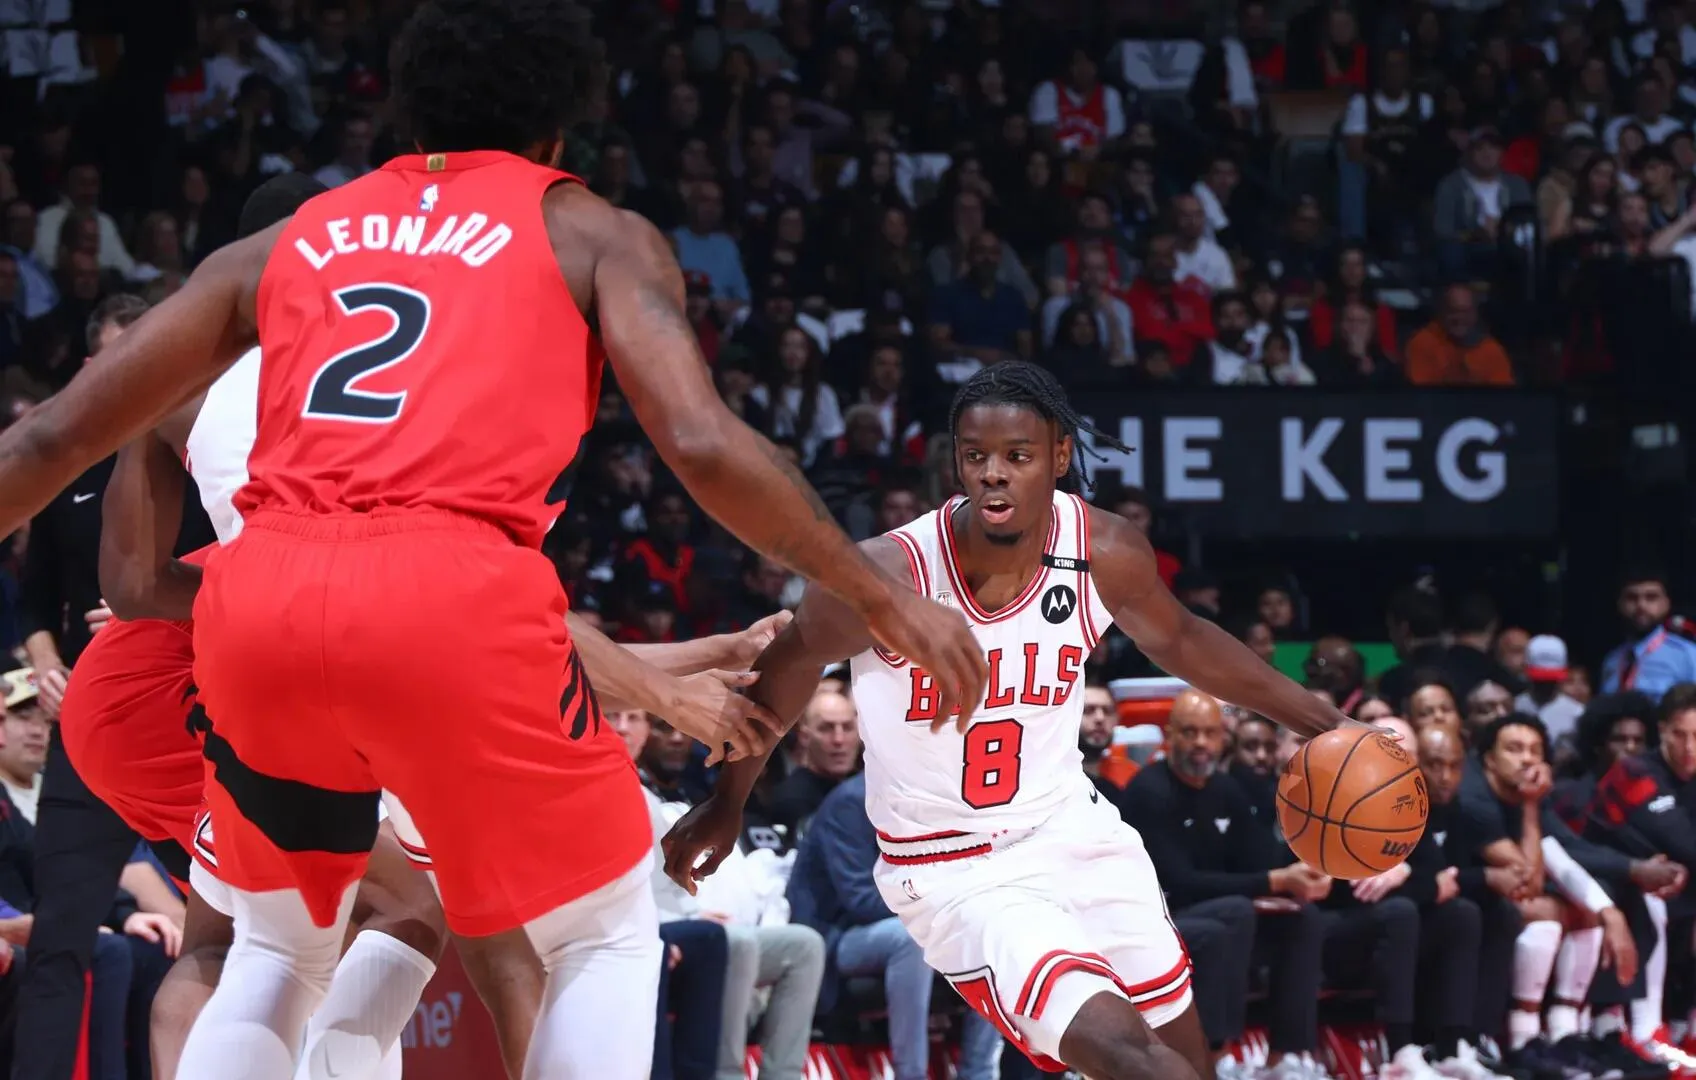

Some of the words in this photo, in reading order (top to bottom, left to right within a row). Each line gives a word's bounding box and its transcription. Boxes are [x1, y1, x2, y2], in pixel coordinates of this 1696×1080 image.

[295, 212, 513, 271] LEONARD
[301, 281, 432, 424] 2
[1076, 416, 1223, 501] HE
[1280, 416, 1507, 502] KEG
[905, 643, 1083, 722] BLLS
[961, 718, 1024, 810] 8
